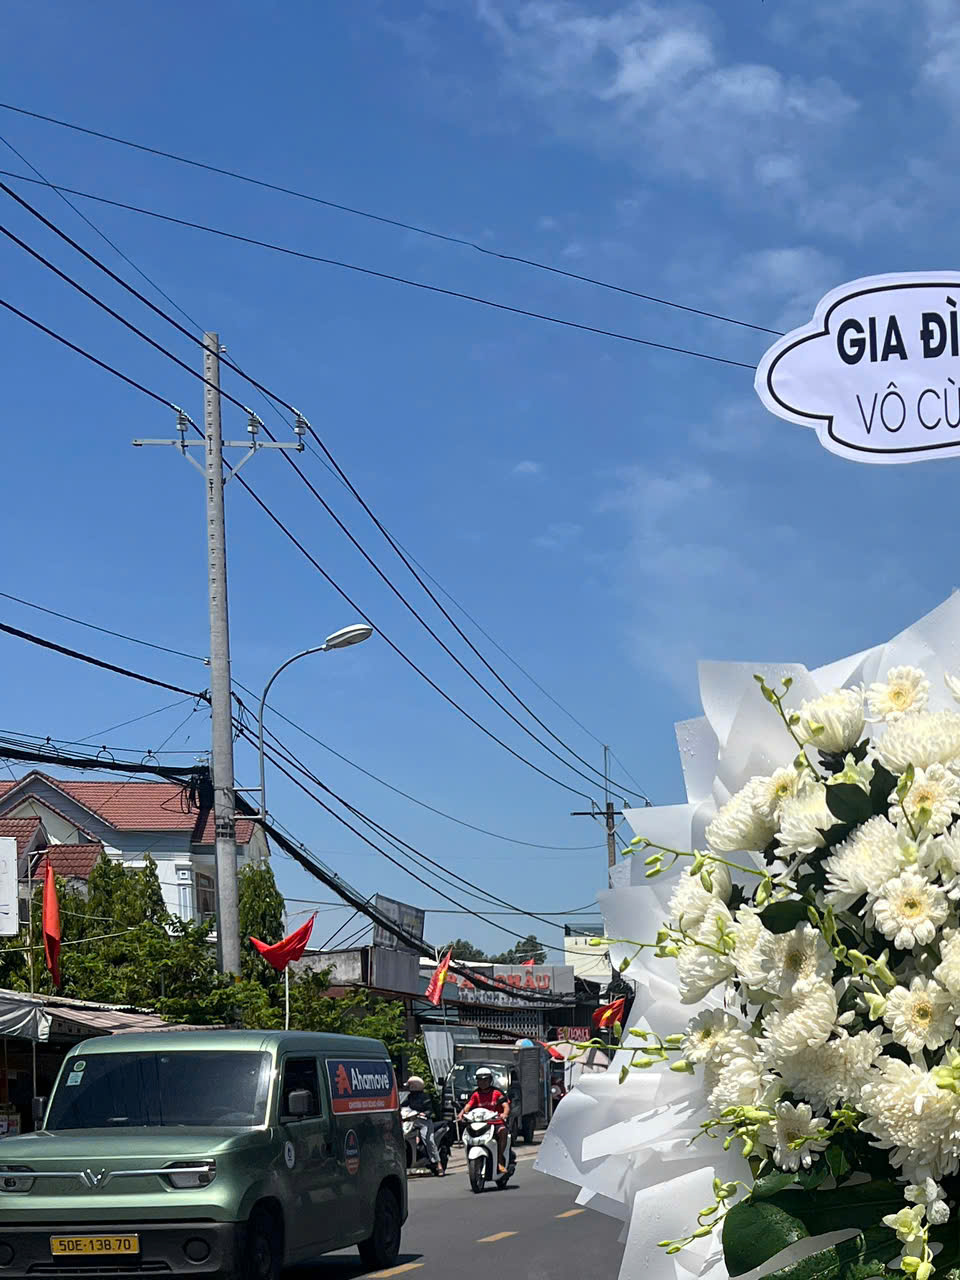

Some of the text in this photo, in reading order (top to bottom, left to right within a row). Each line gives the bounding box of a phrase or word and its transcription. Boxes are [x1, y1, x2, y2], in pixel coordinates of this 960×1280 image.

[836, 315, 908, 366] GIA
[856, 381, 907, 434] VÔ
[351, 1067, 390, 1090] Ahamove
